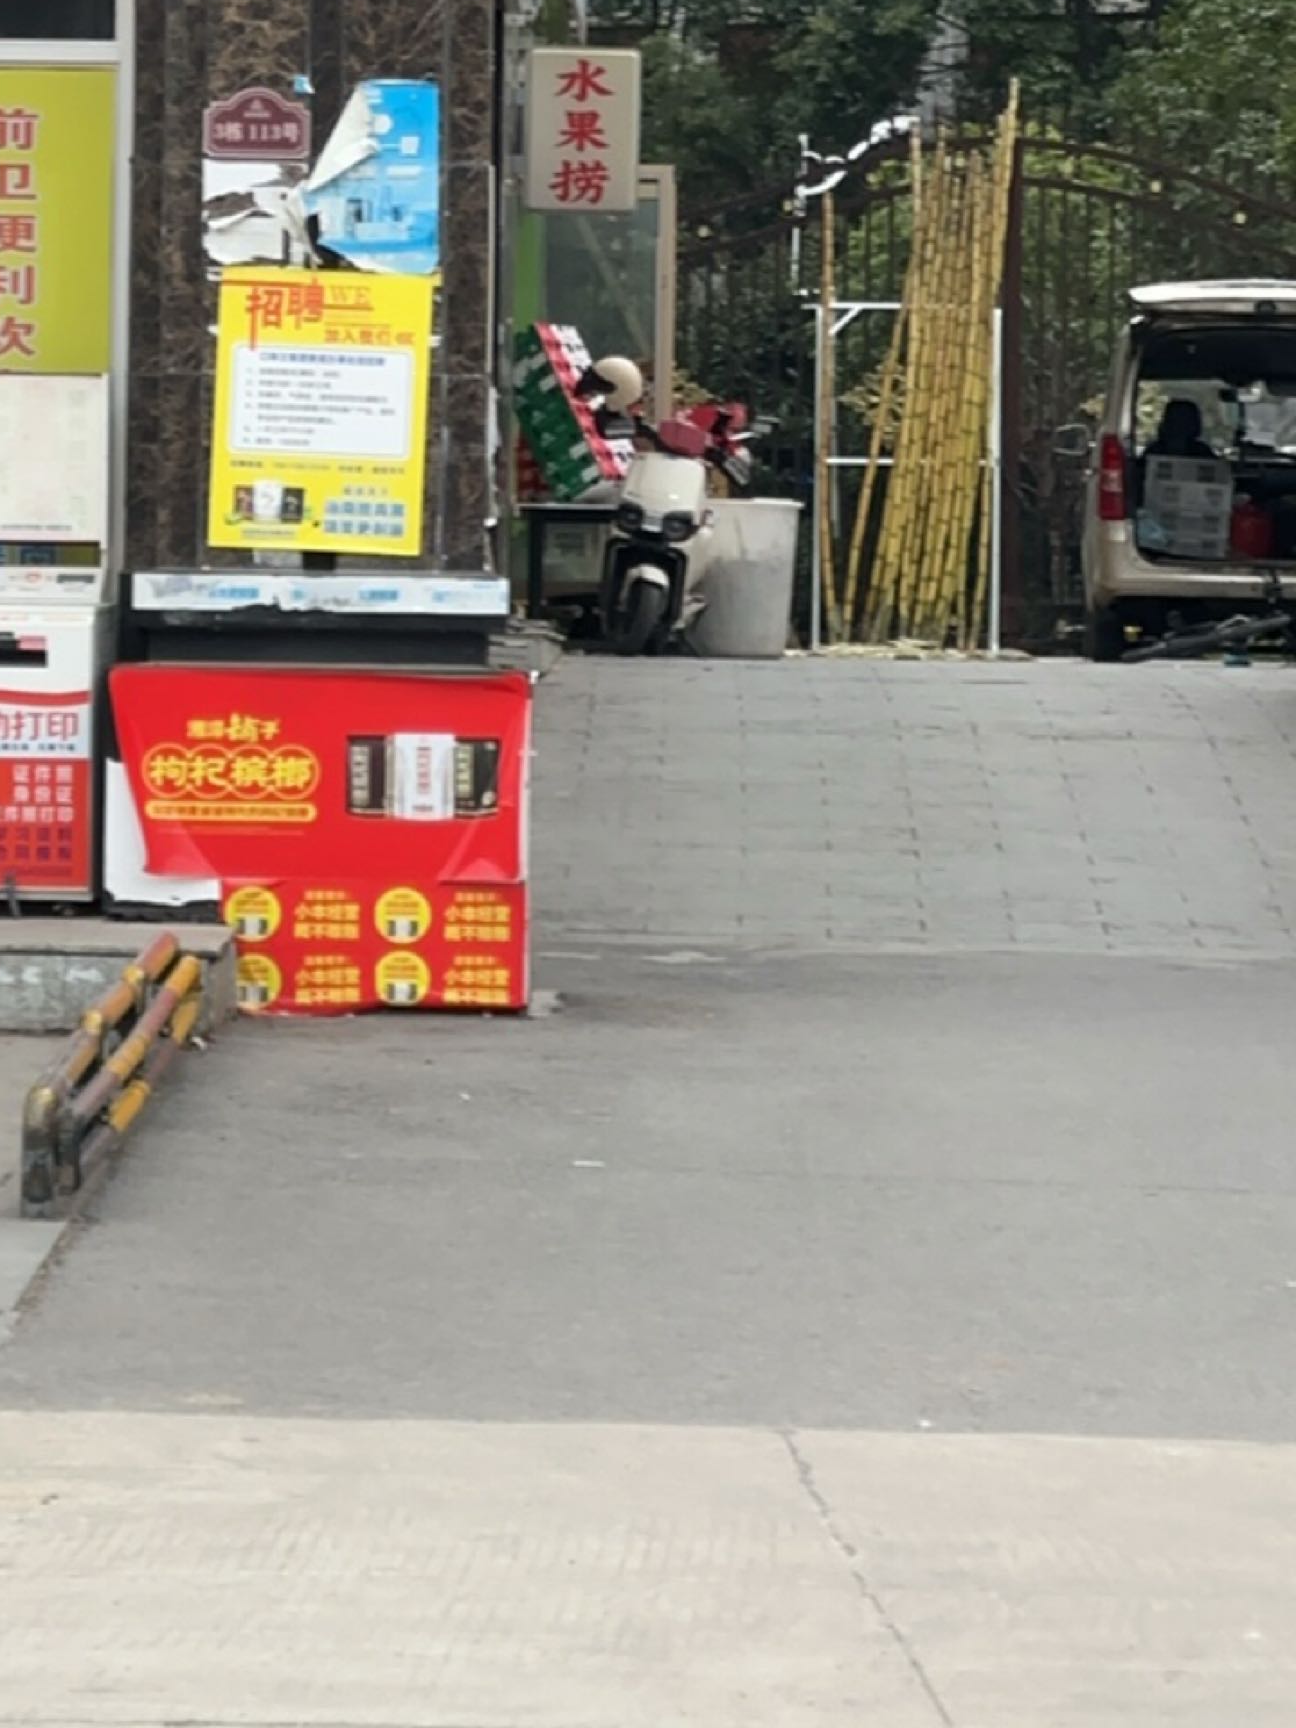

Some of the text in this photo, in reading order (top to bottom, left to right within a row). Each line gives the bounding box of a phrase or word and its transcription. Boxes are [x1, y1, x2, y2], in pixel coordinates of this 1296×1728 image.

[548, 58, 613, 203] 水果捞
[245, 275, 324, 351] 招聘
[150, 754, 313, 788] 枸杞槟榔
